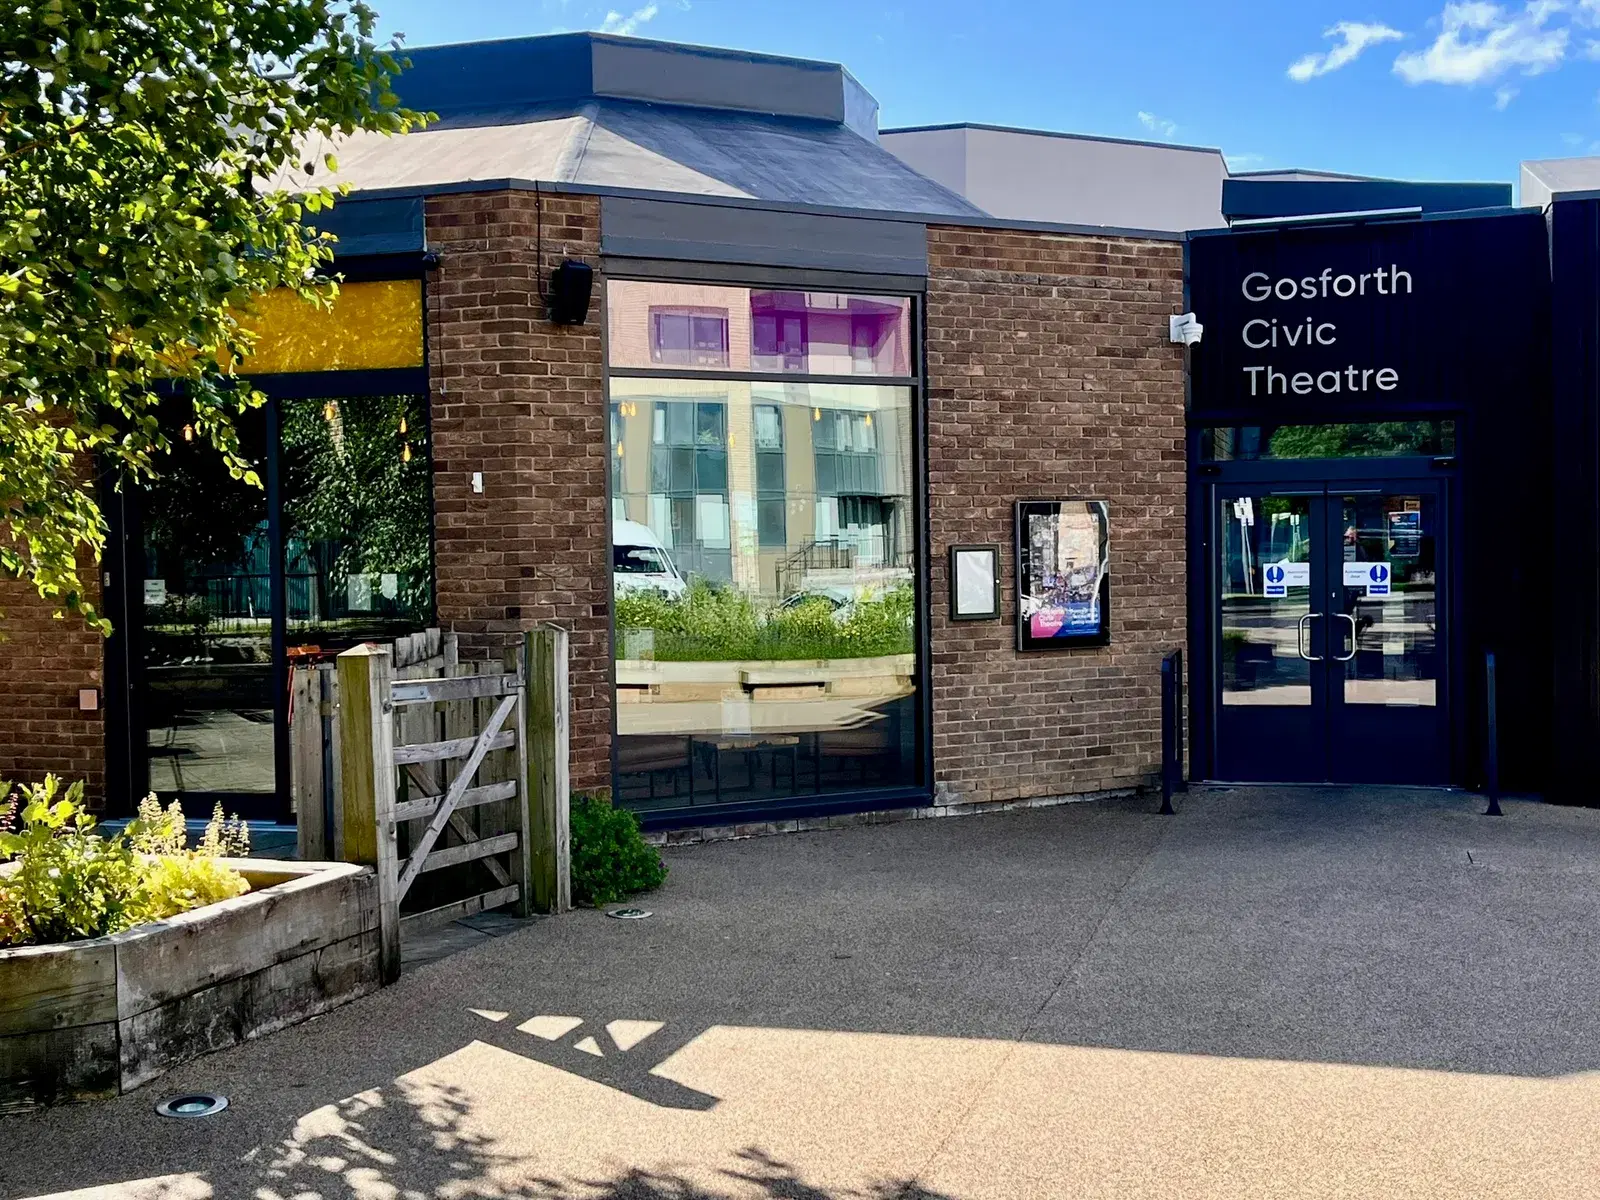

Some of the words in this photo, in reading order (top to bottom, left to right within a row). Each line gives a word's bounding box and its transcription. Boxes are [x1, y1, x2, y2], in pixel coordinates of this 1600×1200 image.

[1242, 264, 1412, 302] Gosforth
[1242, 316, 1337, 349] Civic
[1243, 364, 1399, 396] Theatre
